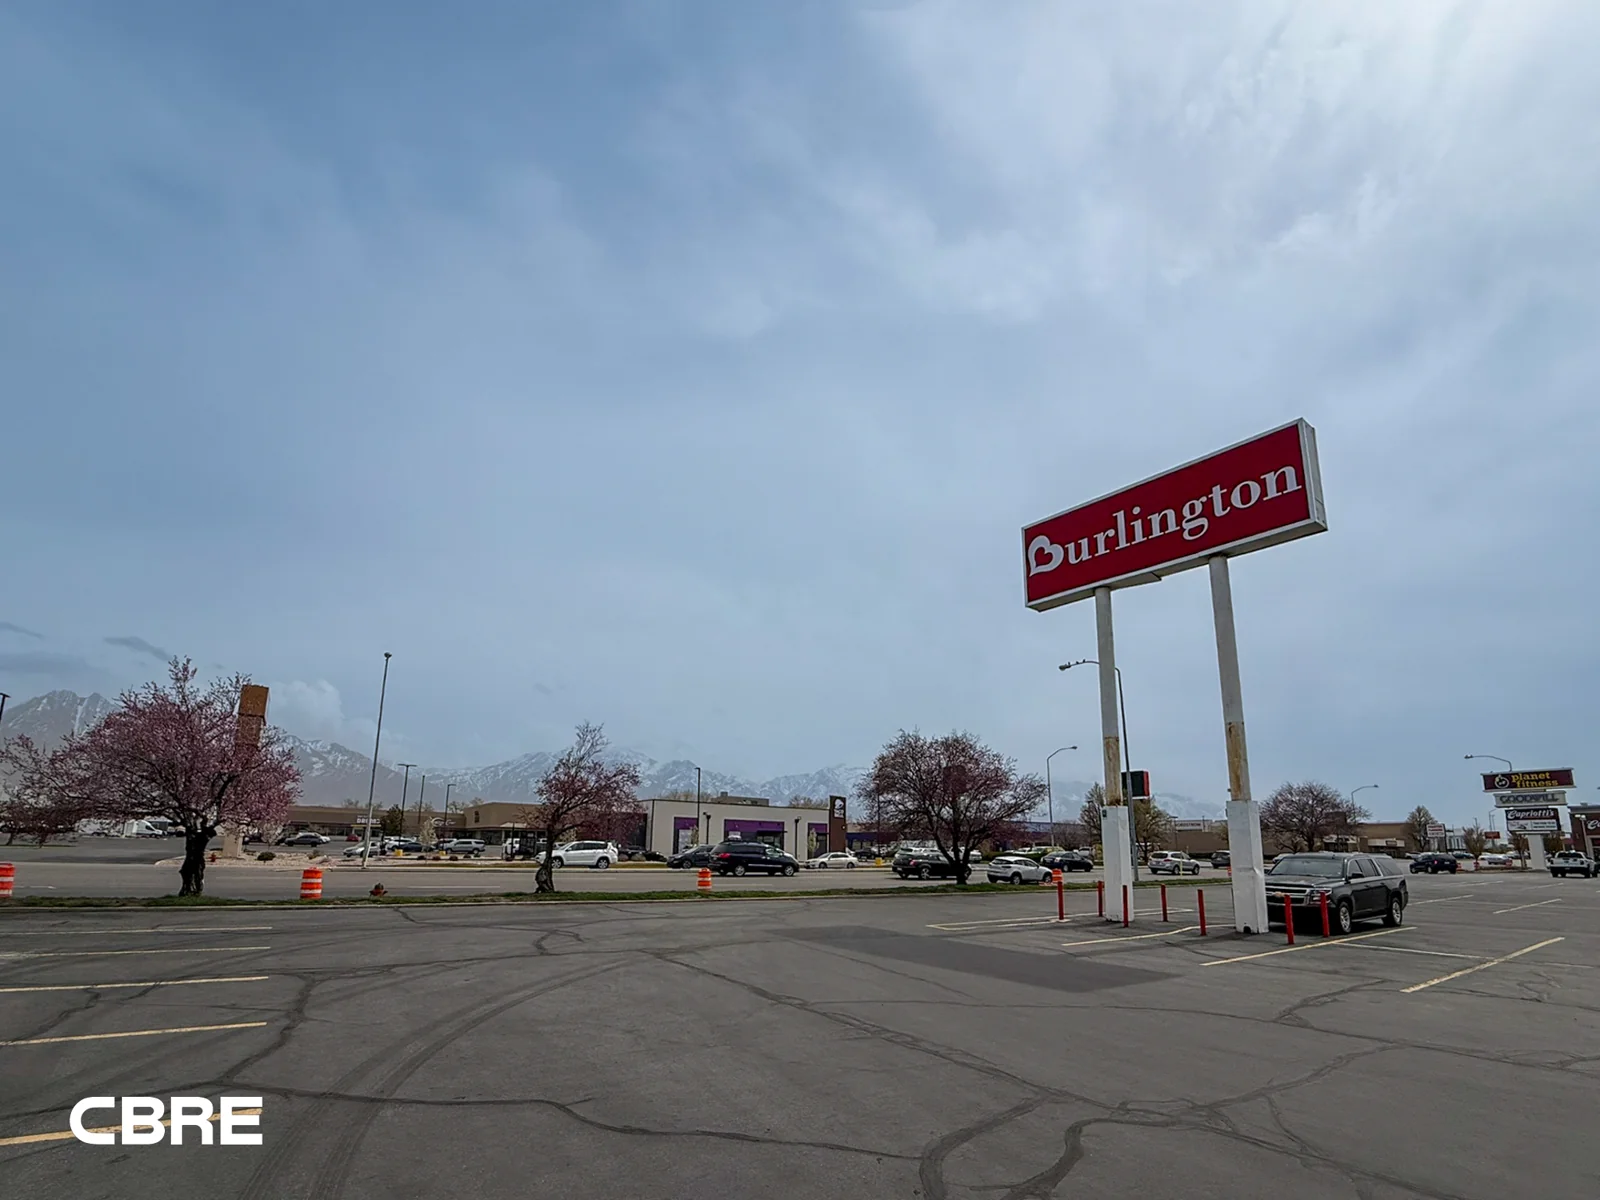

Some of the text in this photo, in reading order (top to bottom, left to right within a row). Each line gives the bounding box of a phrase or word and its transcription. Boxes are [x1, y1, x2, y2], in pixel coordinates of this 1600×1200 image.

[1028, 464, 1302, 577] Burlington
[1511, 772, 1550, 782] planet
[1516, 780, 1559, 788] fitness
[1500, 793, 1559, 804] GOODWILL
[1507, 809, 1555, 819] Capriotti's
